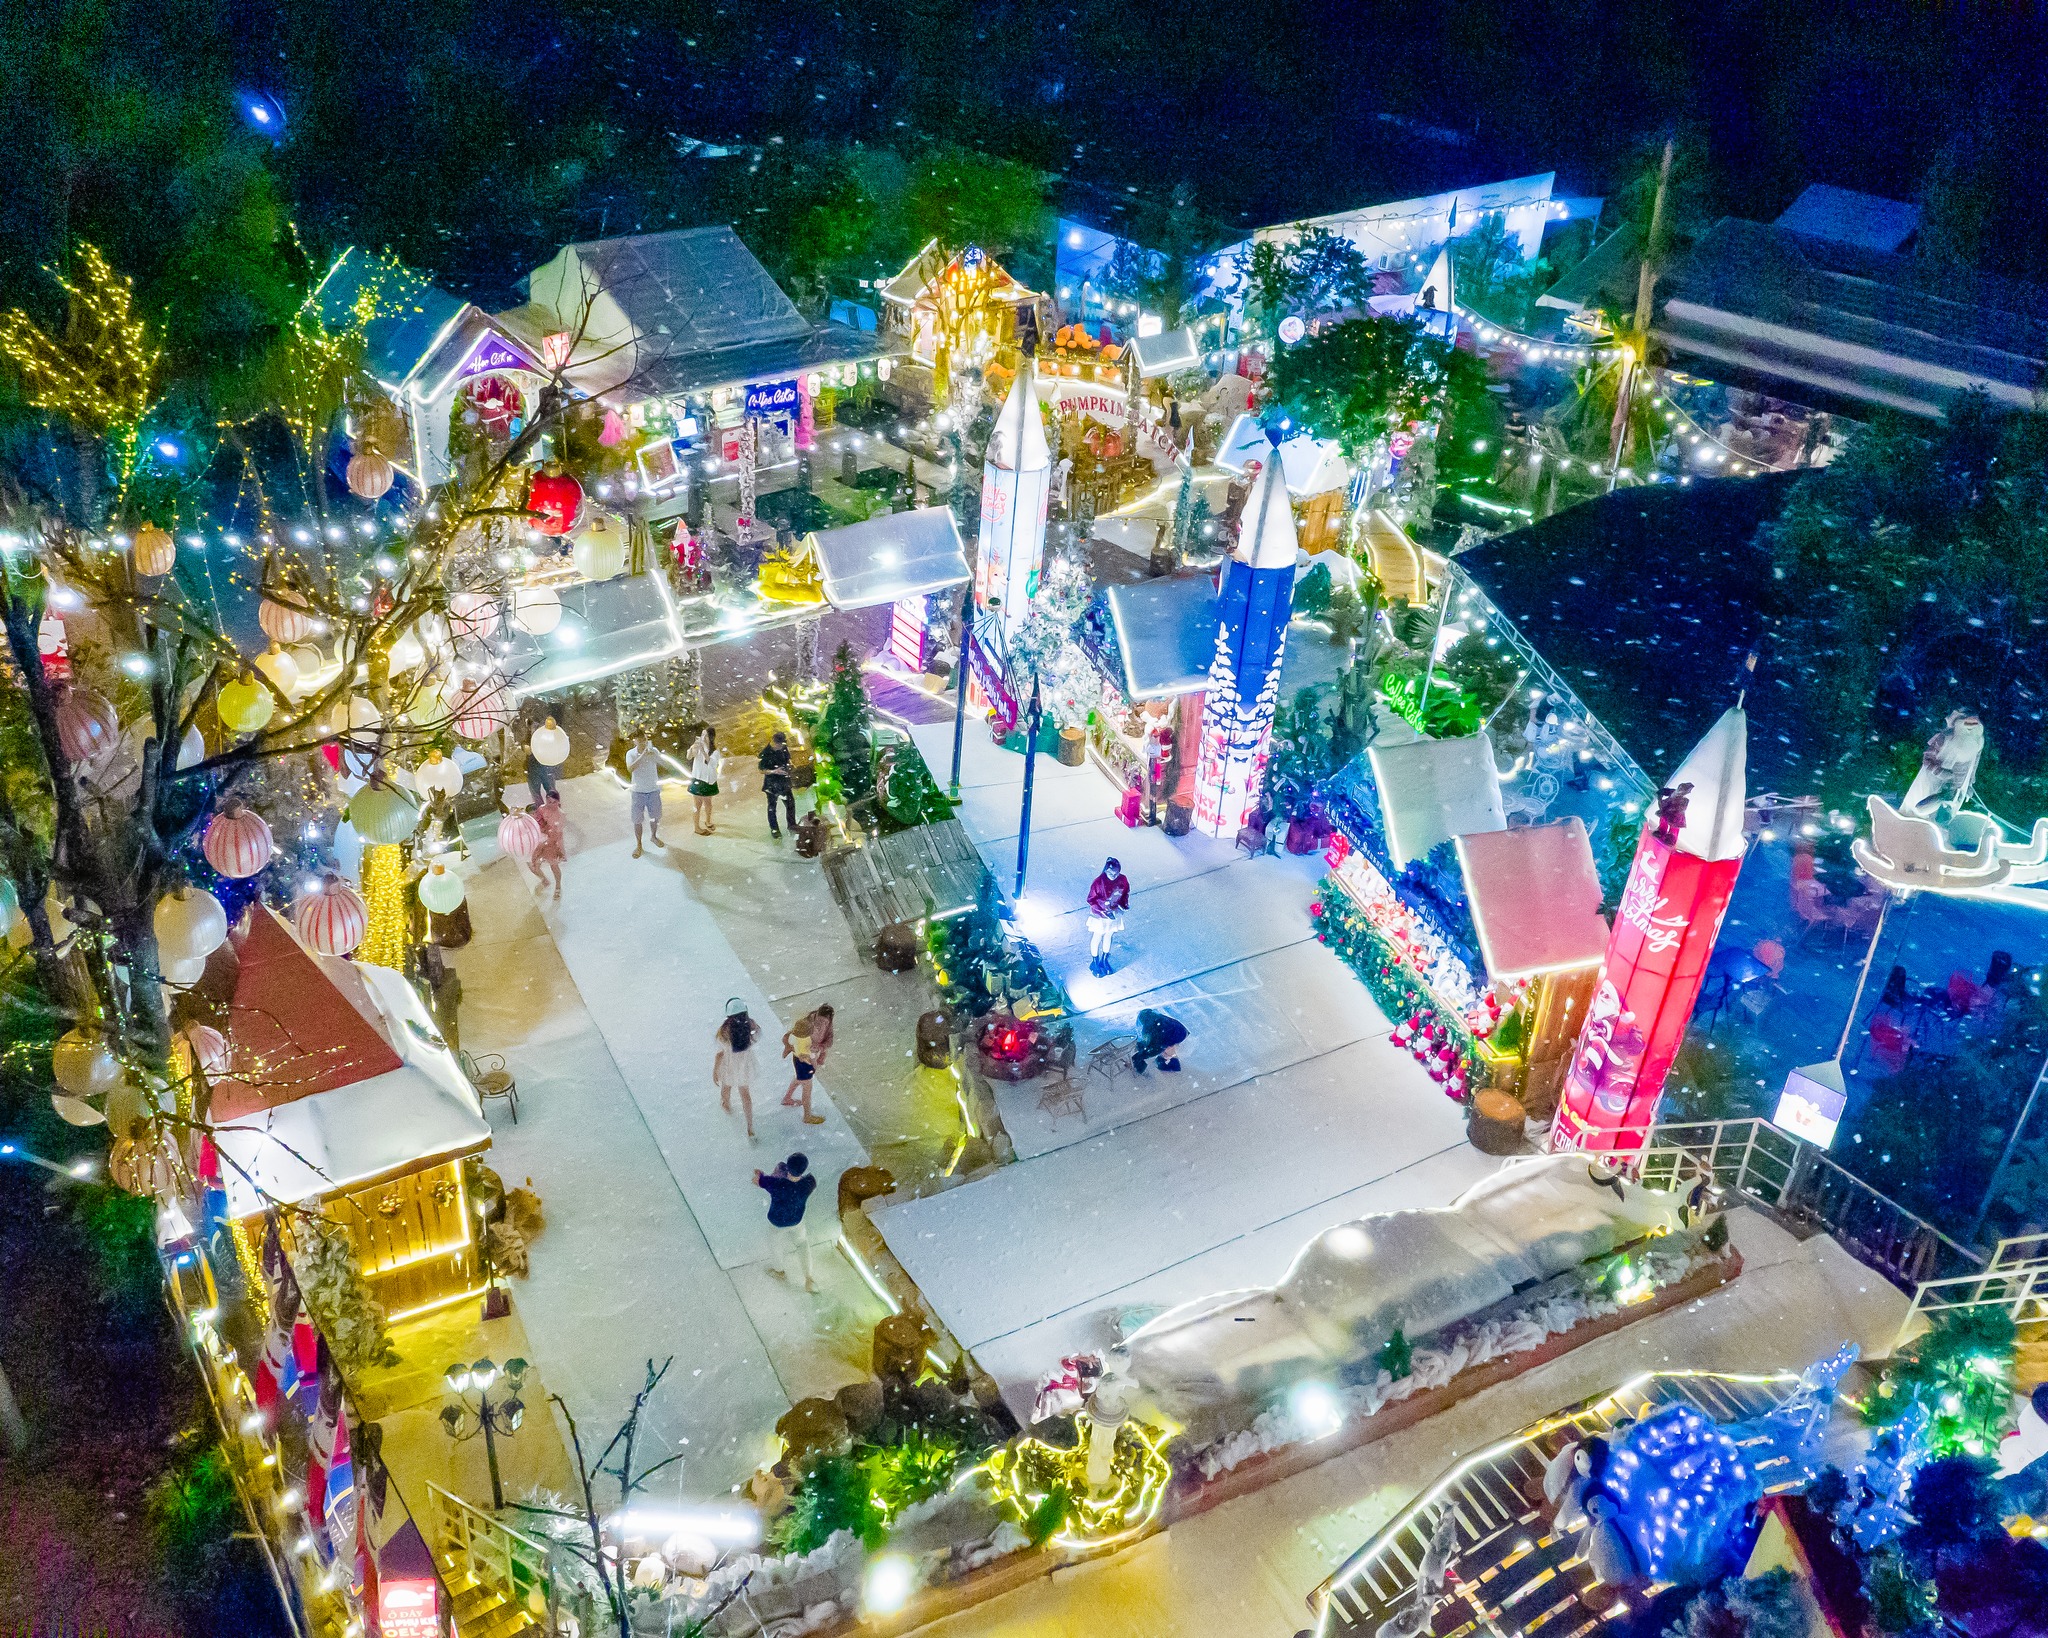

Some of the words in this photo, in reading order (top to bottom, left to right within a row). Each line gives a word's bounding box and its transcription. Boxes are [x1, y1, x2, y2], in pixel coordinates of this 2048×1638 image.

[1059, 395, 1126, 417] PUMPKIN
[1385, 674, 1406, 709] Coffee
[384, 1627, 421, 1638] OEL
